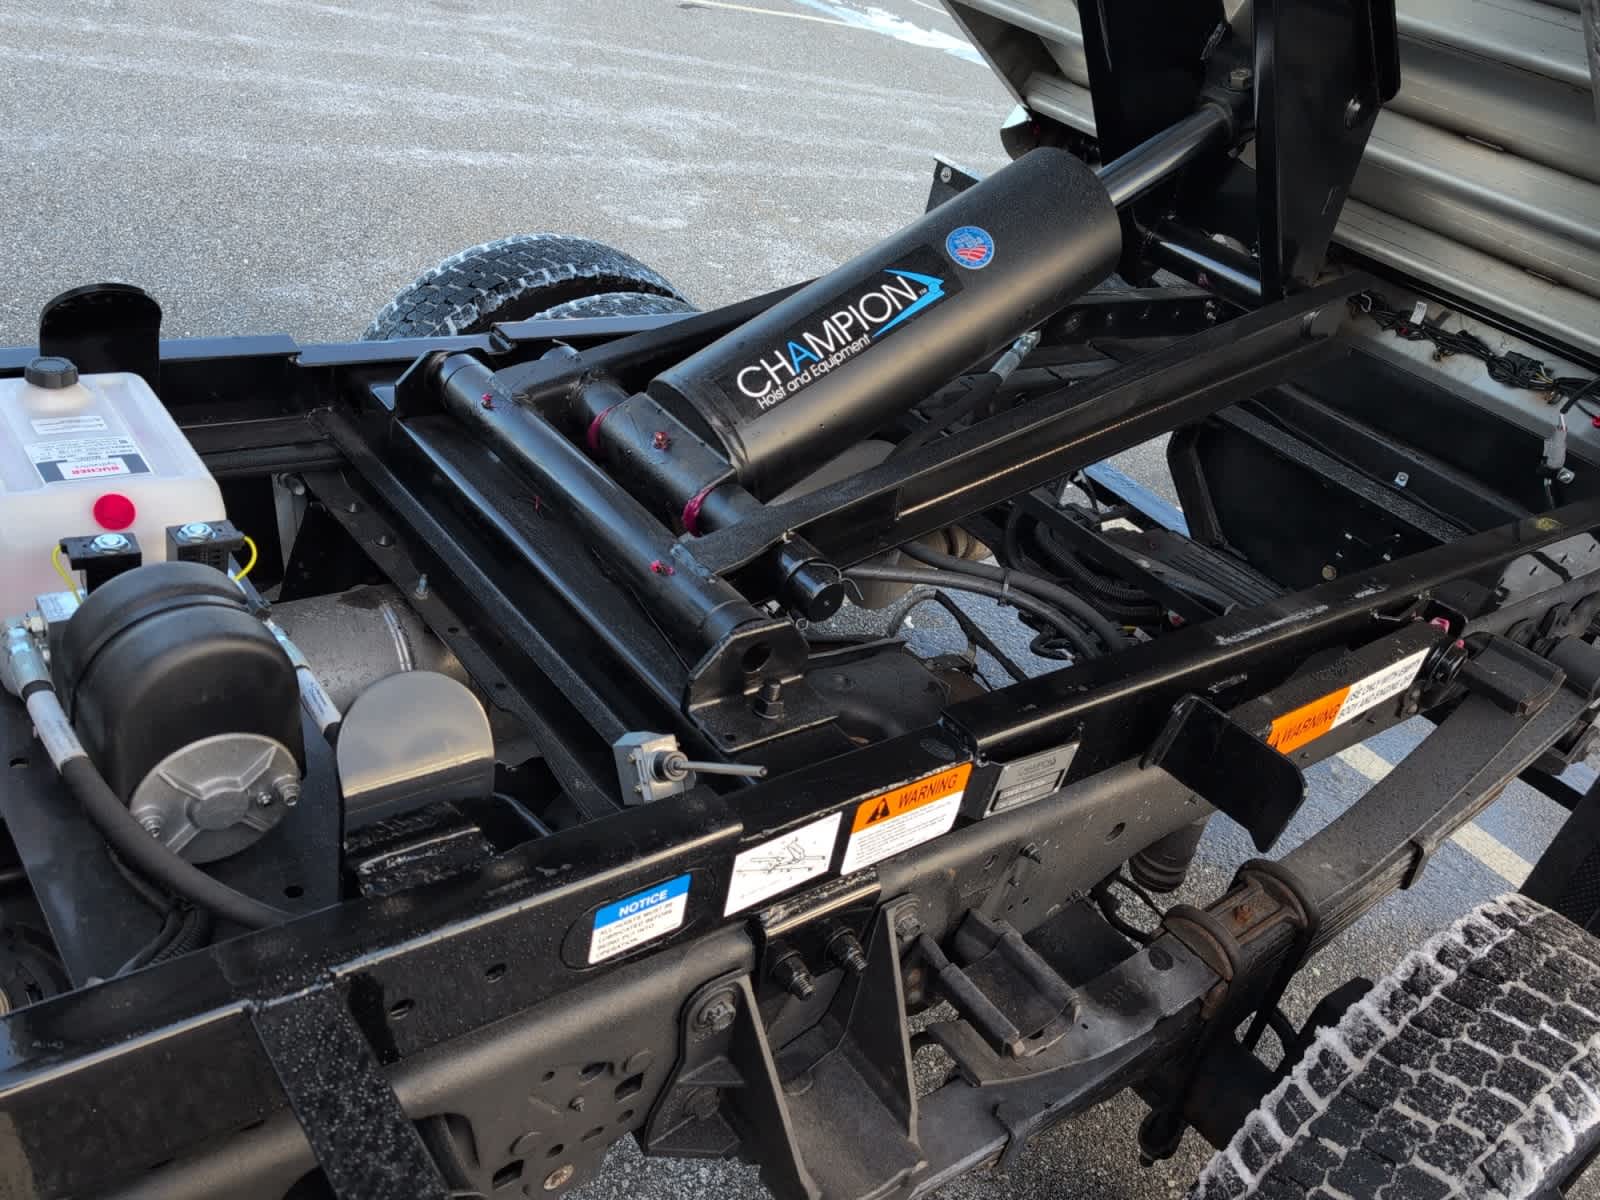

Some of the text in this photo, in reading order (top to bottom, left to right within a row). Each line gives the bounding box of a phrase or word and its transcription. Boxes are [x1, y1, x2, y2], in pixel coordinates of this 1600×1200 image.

[737, 275, 918, 398] CHAMPION
[757, 333, 871, 409] Hoist and Equipment
[1281, 703, 1341, 744] WARNING
[899, 774, 958, 808] WARNING
[619, 889, 668, 917] NOTICE
